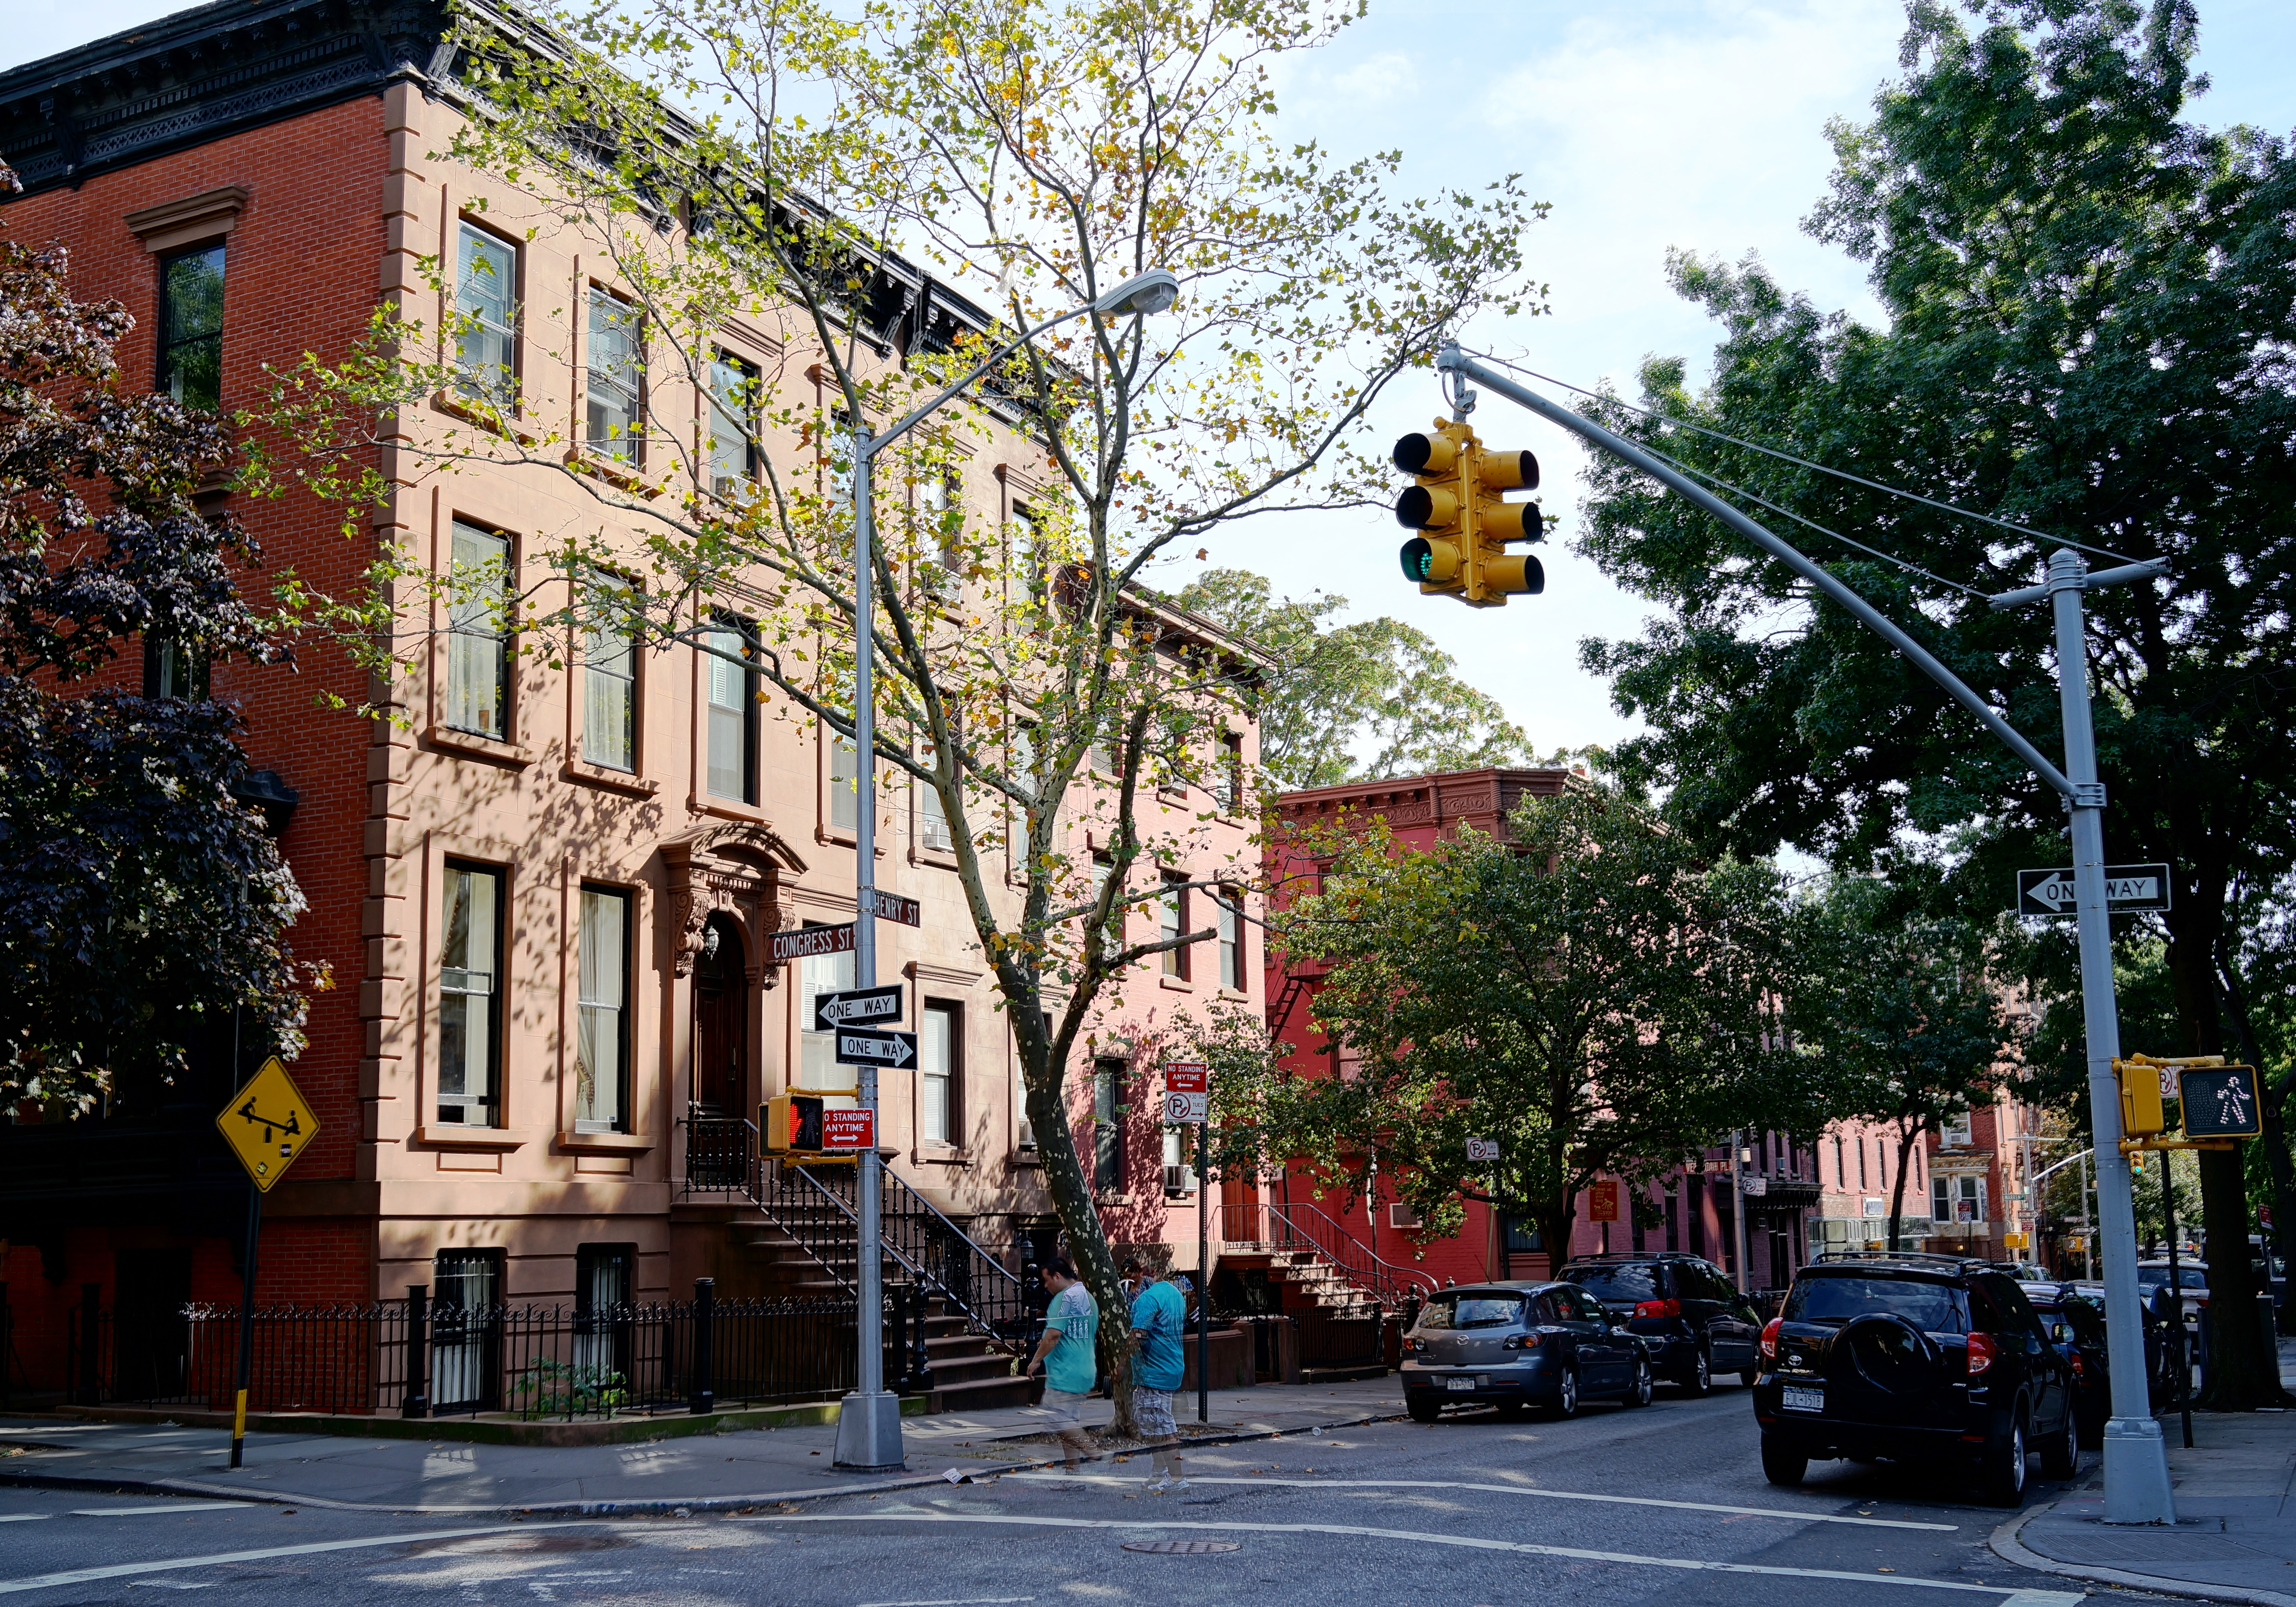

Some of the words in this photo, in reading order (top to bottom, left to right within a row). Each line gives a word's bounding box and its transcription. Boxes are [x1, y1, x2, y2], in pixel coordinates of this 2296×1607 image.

[2046, 883, 2074, 900] ON
[2106, 879, 2146, 897] WAY
[875, 894, 902, 921] HENRY
[907, 903, 917, 925] ST
[774, 930, 832, 958] CONGRESS
[838, 928, 850, 950] ST
[828, 1002, 852, 1018] ONE
[864, 997, 891, 1014] WAY
[848, 1039, 871, 1055] ONE
[881, 1042, 905, 1058] WAY
[824, 1113, 829, 1121] O
[833, 1112, 870, 1121] STANDING
[825, 1123, 864, 1132] ANYTIME
[1686, 1162, 1718, 1173] VERDAH
[1720, 1162, 1729, 1171] PL
